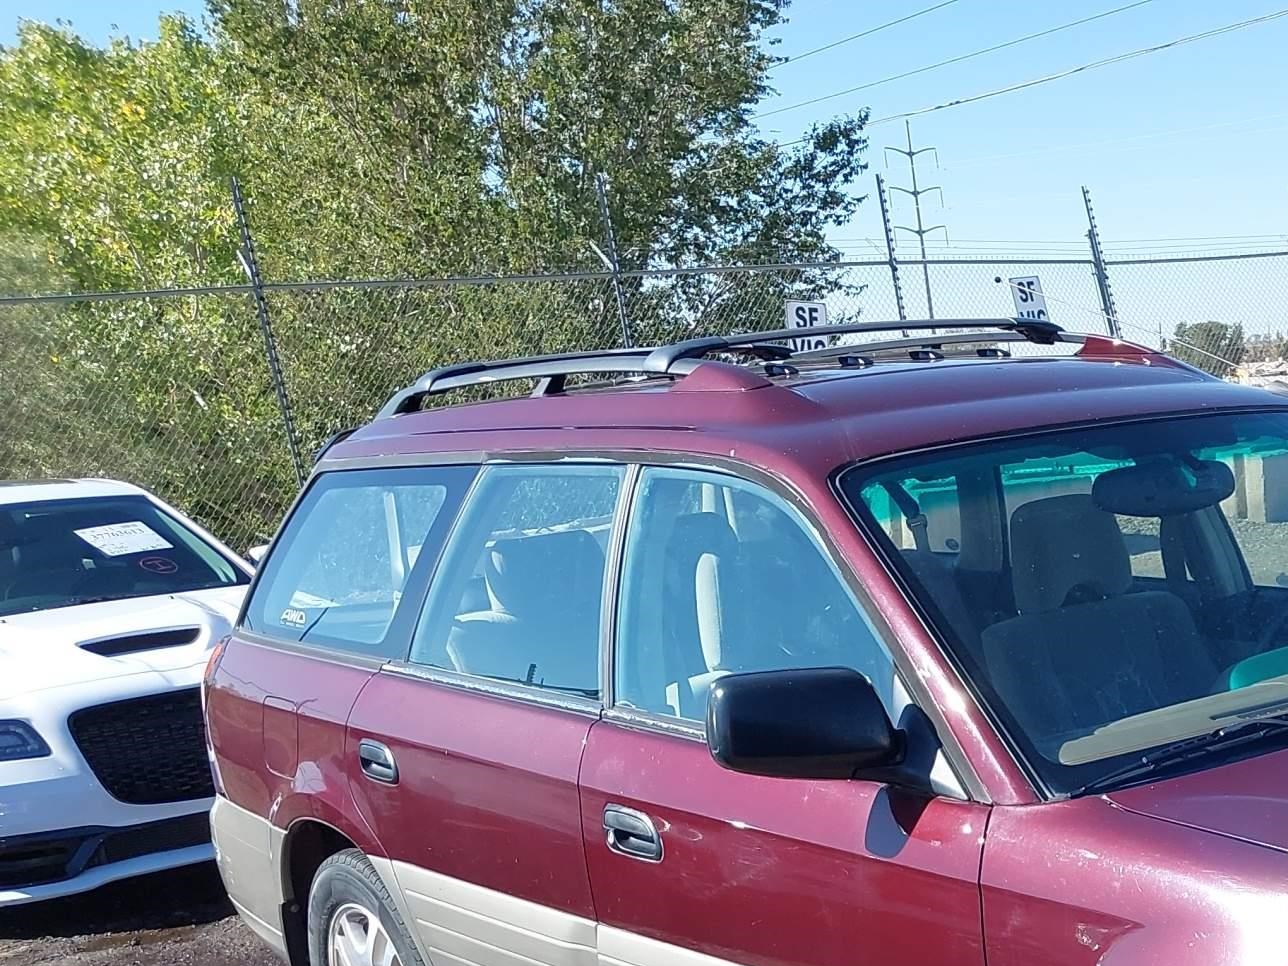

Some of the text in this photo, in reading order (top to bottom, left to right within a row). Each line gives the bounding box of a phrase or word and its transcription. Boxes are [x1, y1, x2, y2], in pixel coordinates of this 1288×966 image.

[1017, 281, 1035, 303] SF
[795, 305, 819, 328] SF
[280, 608, 306, 624] AWD
